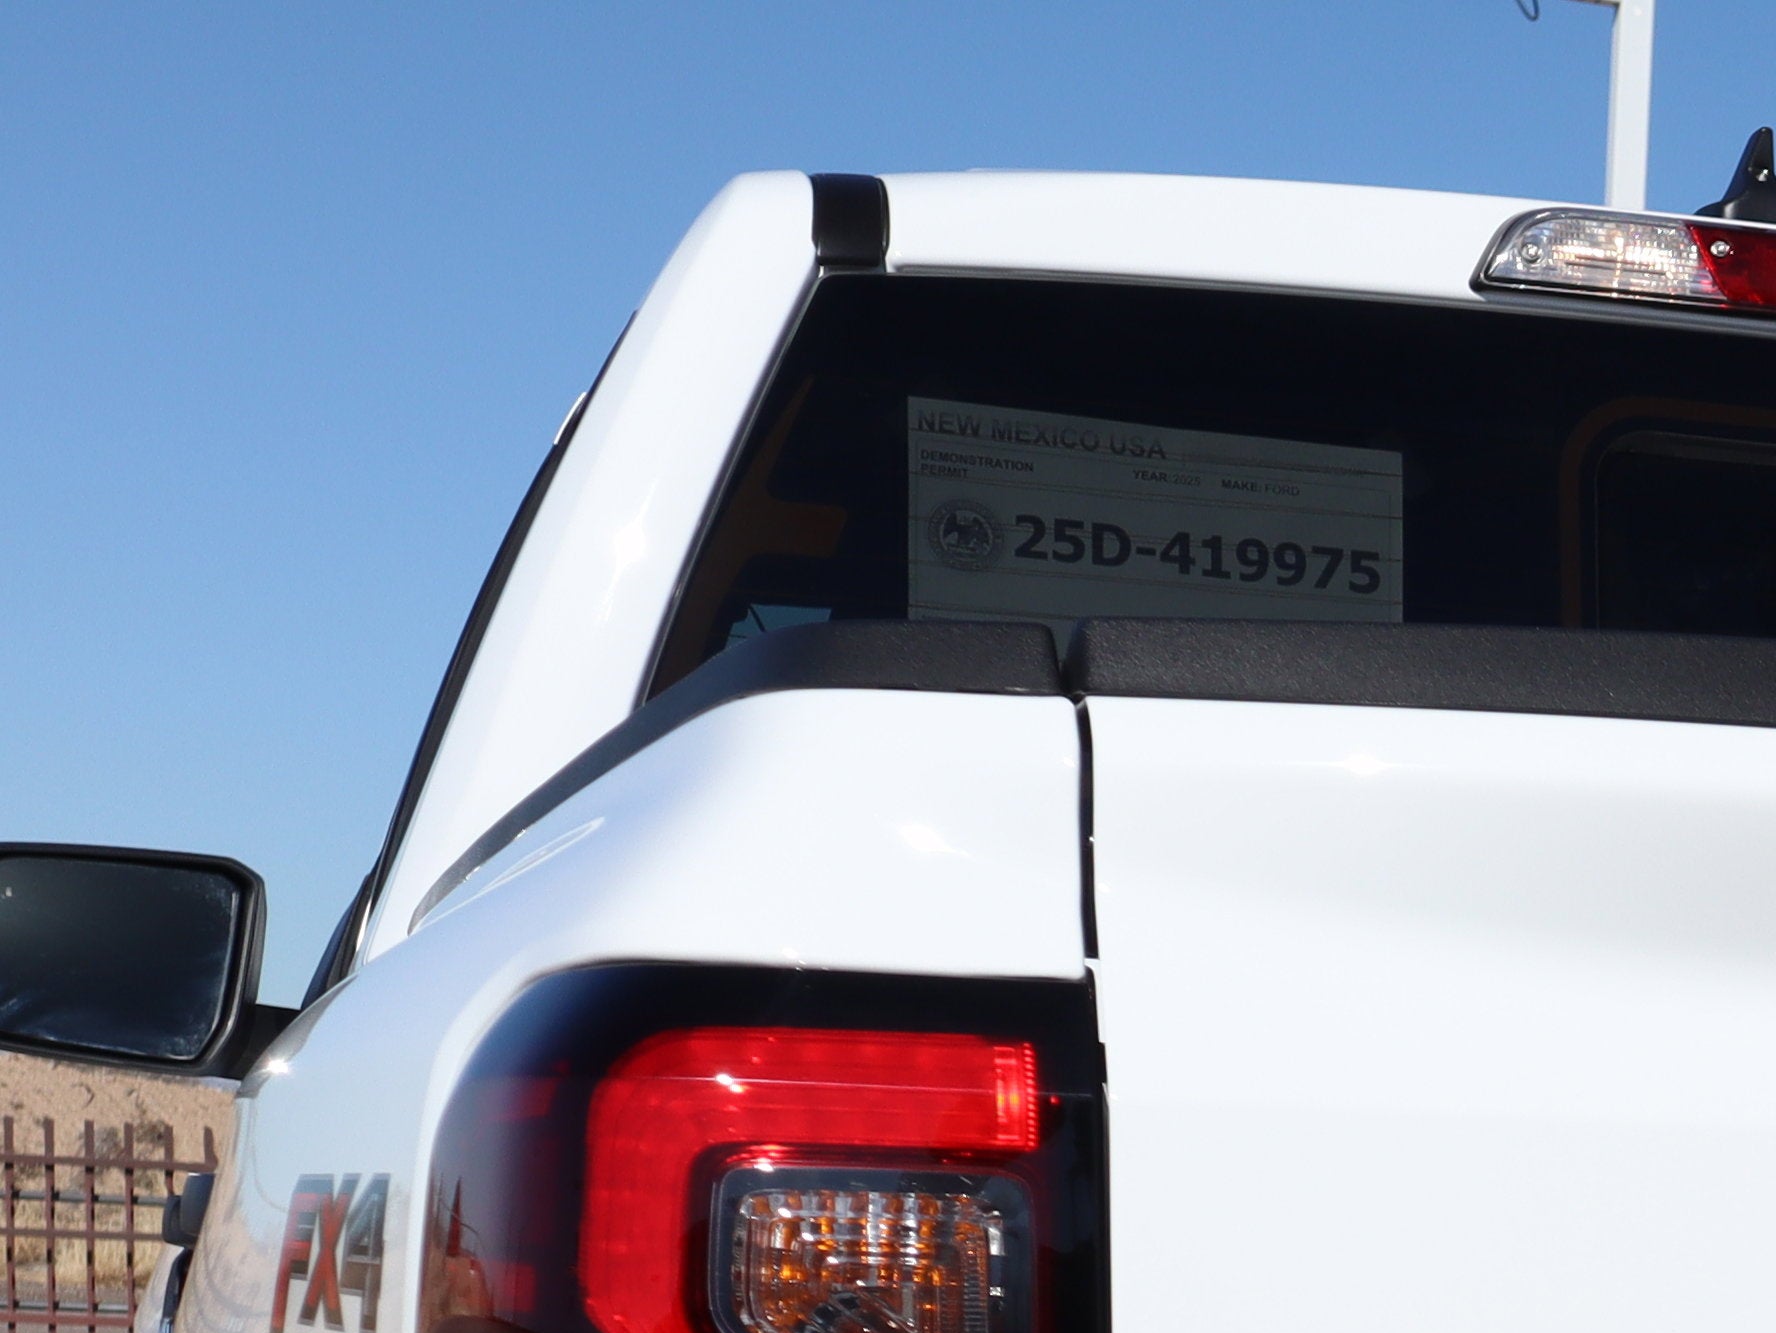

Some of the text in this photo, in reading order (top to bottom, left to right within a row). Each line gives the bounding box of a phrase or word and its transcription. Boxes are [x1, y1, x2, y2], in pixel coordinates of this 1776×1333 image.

[918, 410, 1168, 460] NEW MEXICO USA
[920, 449, 1034, 474] DEMONSTRATION
[920, 463, 969, 480] PERMIT
[1264, 483, 1301, 498] FORD
[1013, 513, 1382, 595] 25D-419975
